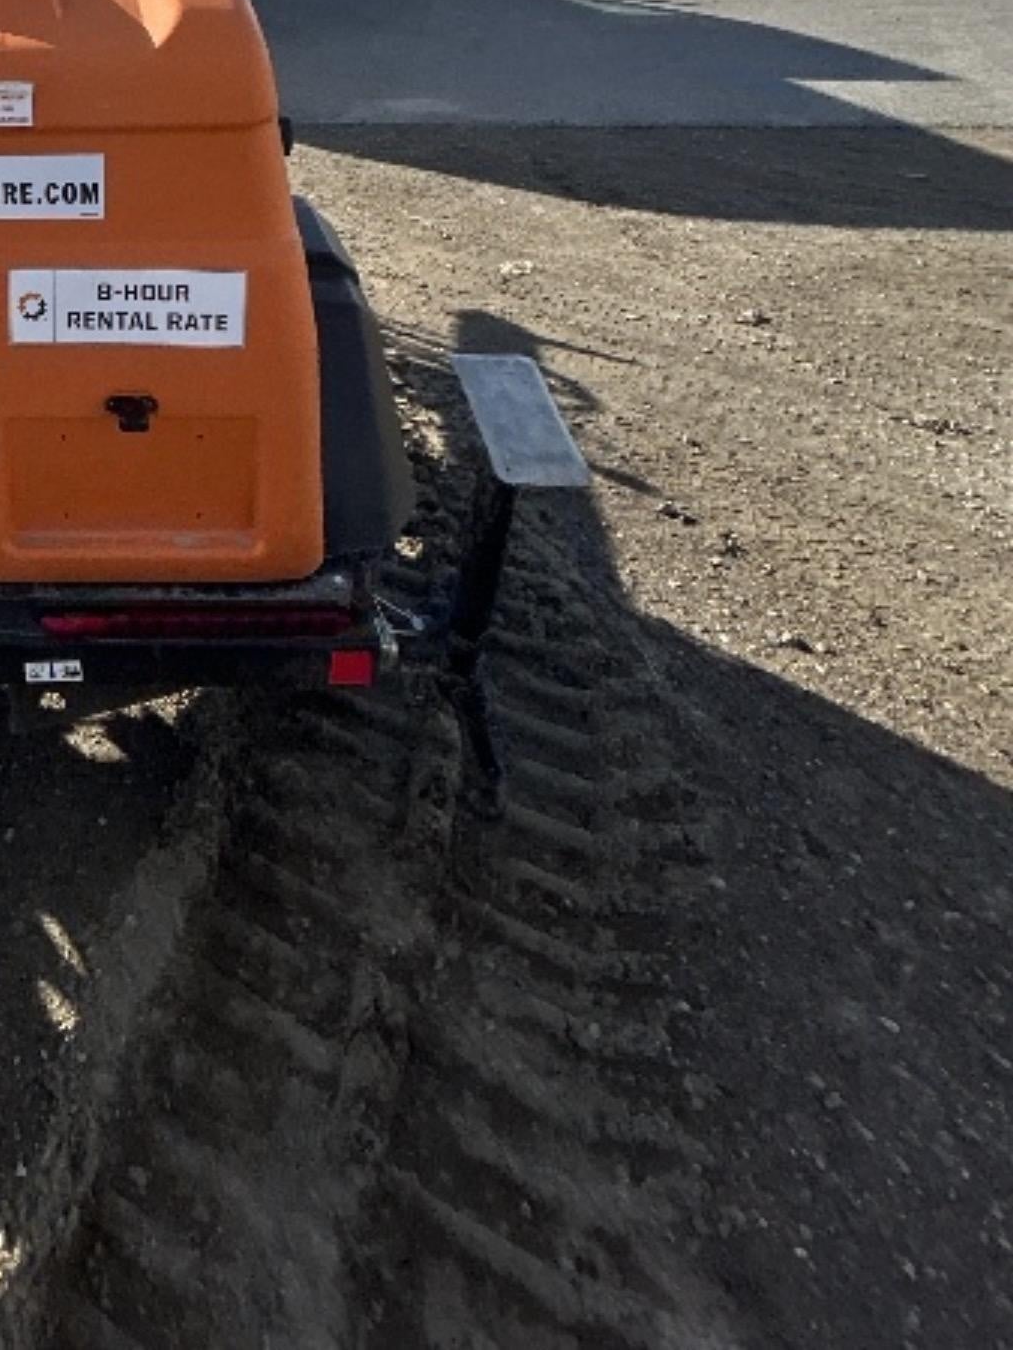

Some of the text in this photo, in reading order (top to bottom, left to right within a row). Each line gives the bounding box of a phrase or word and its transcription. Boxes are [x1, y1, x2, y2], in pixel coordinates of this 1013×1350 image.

[96, 283, 190, 302] 8-HOUR
[66, 310, 229, 332] RENTAL RATE
